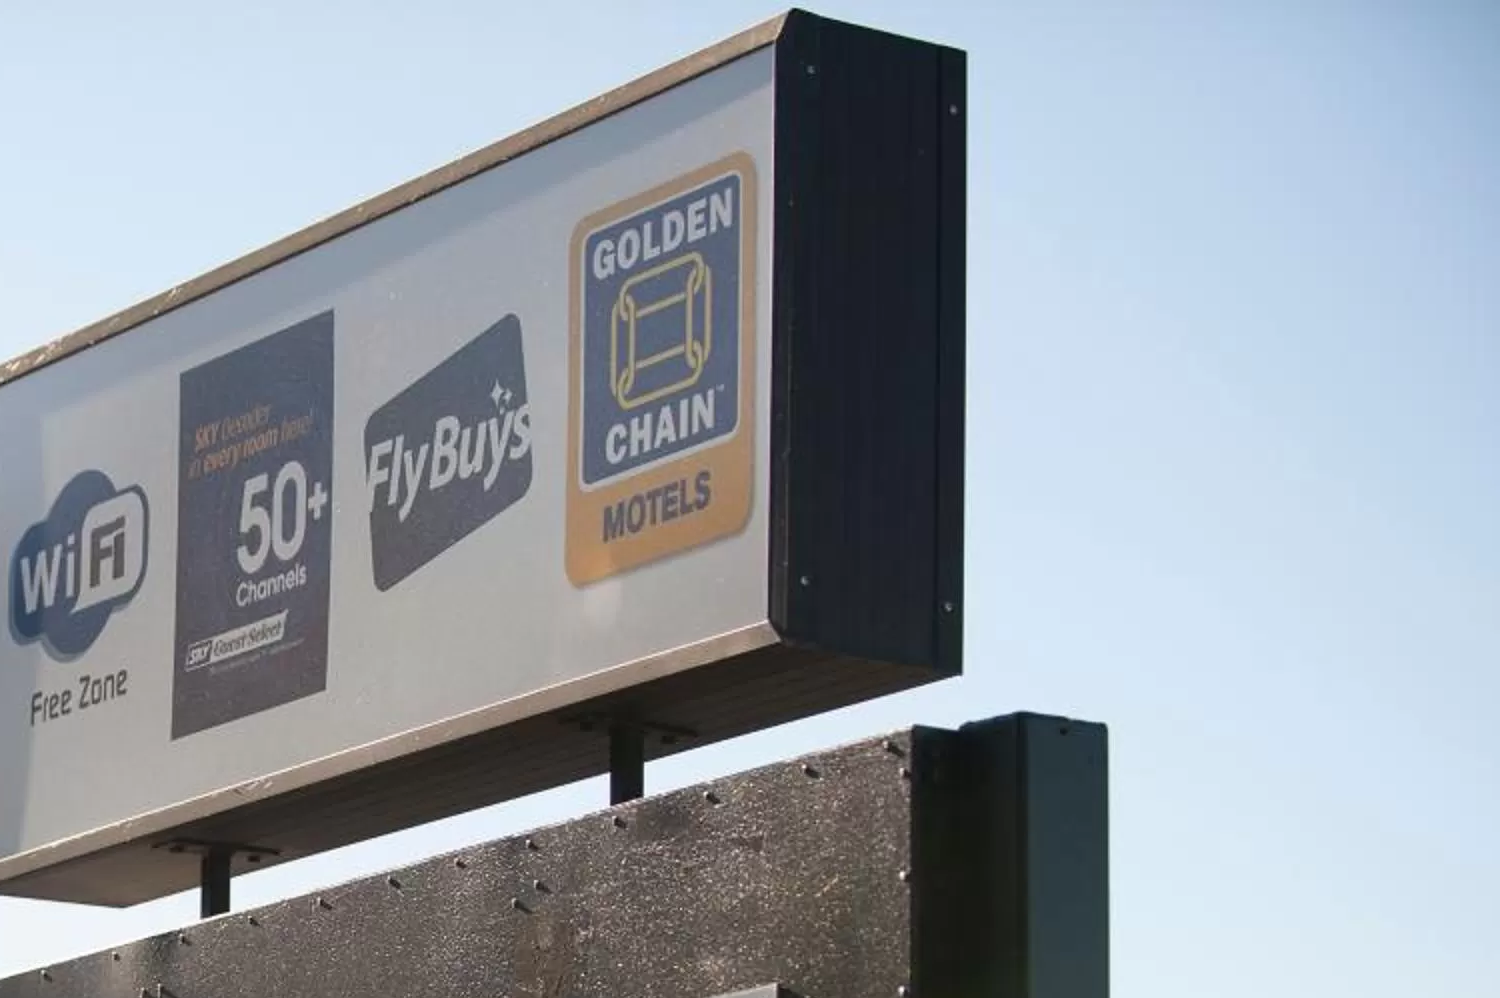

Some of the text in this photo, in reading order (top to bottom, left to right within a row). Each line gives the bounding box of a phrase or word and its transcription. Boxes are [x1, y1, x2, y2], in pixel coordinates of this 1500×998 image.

[592, 187, 734, 280] GOLDEN
[203, 444, 241, 475] every
[243, 427, 279, 457] room
[605, 387, 715, 464] CHAIN
[367, 402, 532, 524] FlyBuys
[236, 460, 328, 574] 50+
[602, 471, 712, 543] MOTELS
[235, 562, 307, 607] Channels
[248, 619, 283, 647] Select
[30, 668, 128, 726] Free Zone
